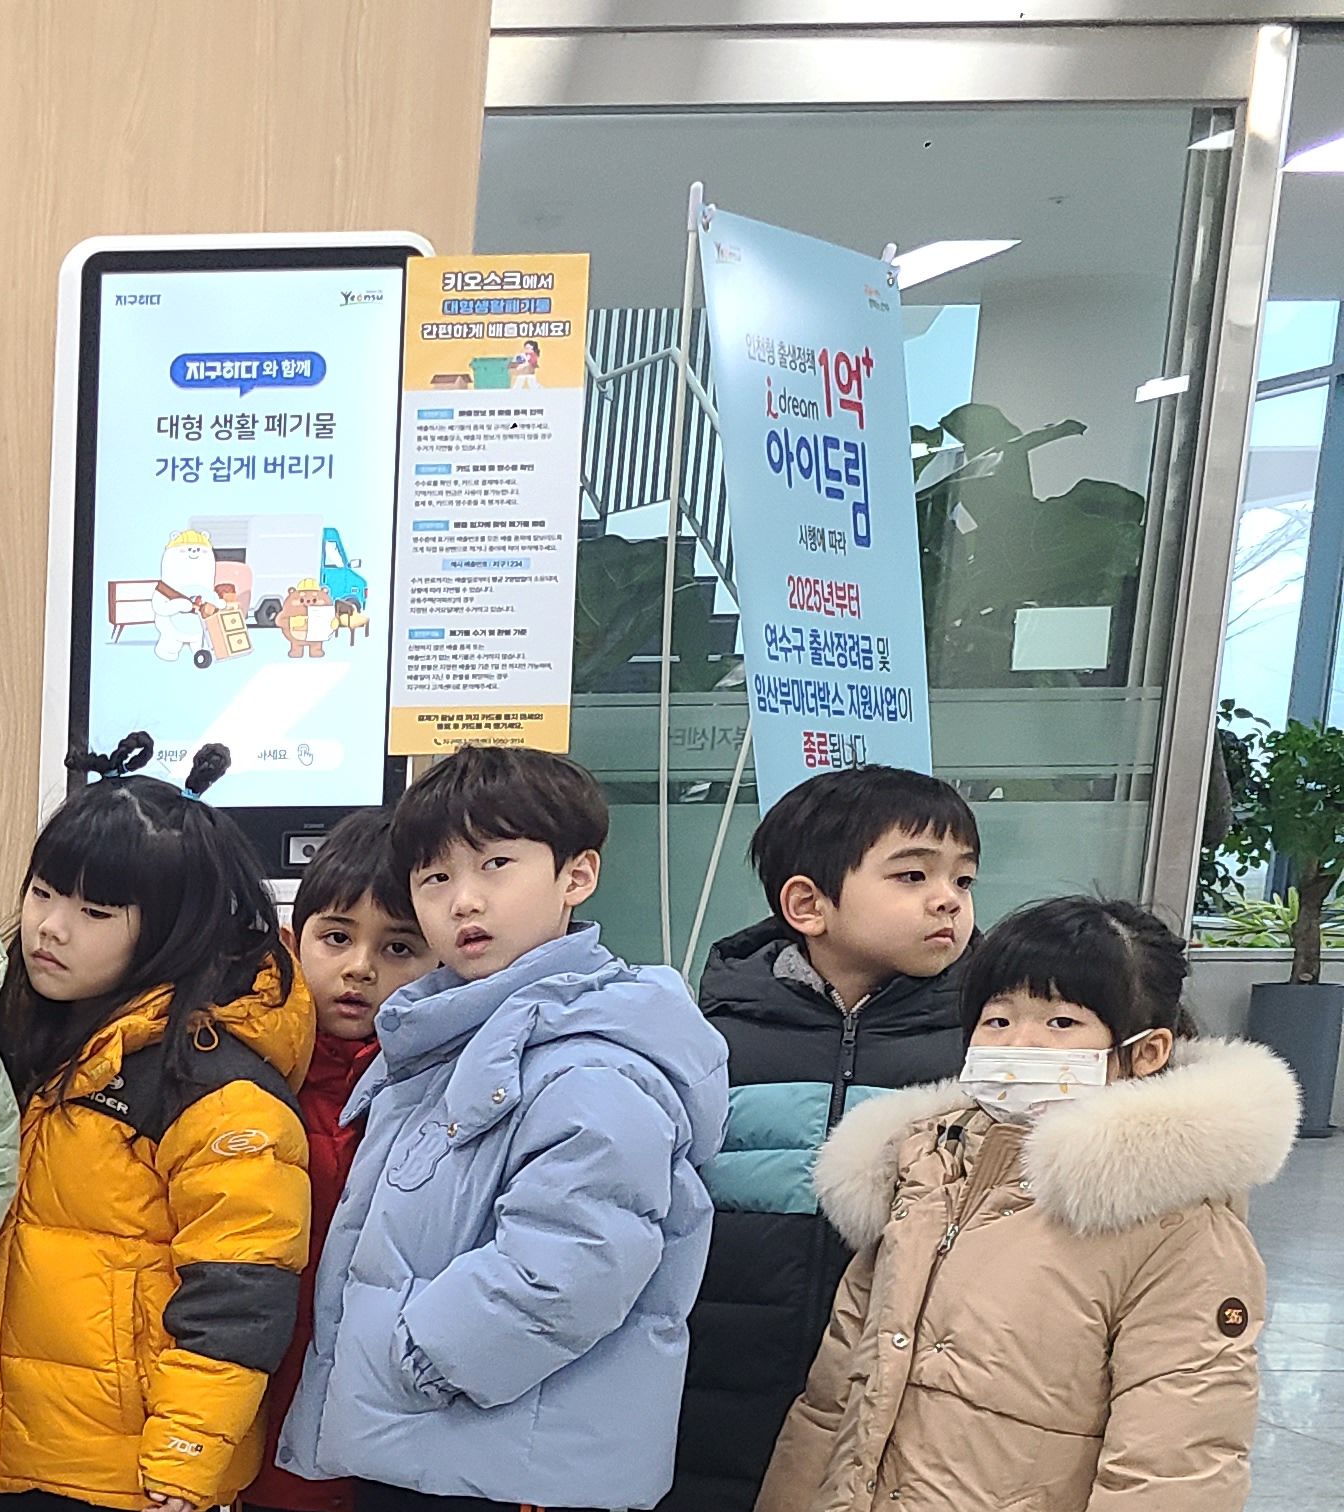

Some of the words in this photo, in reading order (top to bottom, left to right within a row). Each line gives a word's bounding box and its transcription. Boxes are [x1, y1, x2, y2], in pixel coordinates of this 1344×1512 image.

[341, 291, 383, 303] Yeonsu
[443, 273, 553, 290] 키오스크에서
[422, 323, 483, 339] 간편하게
[488, 322, 570, 337] 배출하세요!
[282, 360, 311, 378] 함께
[745, 333, 775, 366] 인천형
[777, 341, 816, 376] 출생정책
[778, 387, 819, 421] dream
[157, 414, 203, 441] 대형
[210, 413, 259, 441] 생활
[265, 413, 336, 439] 폐기물
[155, 456, 203, 483] 가장
[210, 455, 256, 483] 쉽게
[264, 454, 333, 480] 버리기
[766, 427, 871, 549] 아이드림
[799, 524, 826, 553] 시행에
[829, 527, 846, 555] 따라
[787, 575, 861, 620] 2025년부터
[764, 623, 805, 665] 연수구
[809, 629, 873, 672] 출산장려금
[877, 637, 890, 673] 및
[754, 674, 845, 718] 임산부마더박스
[847, 682, 913, 723] 지원사업이
[803, 731, 866, 769] 종료됩니다
[85, 1092, 128, 1115] IDER
